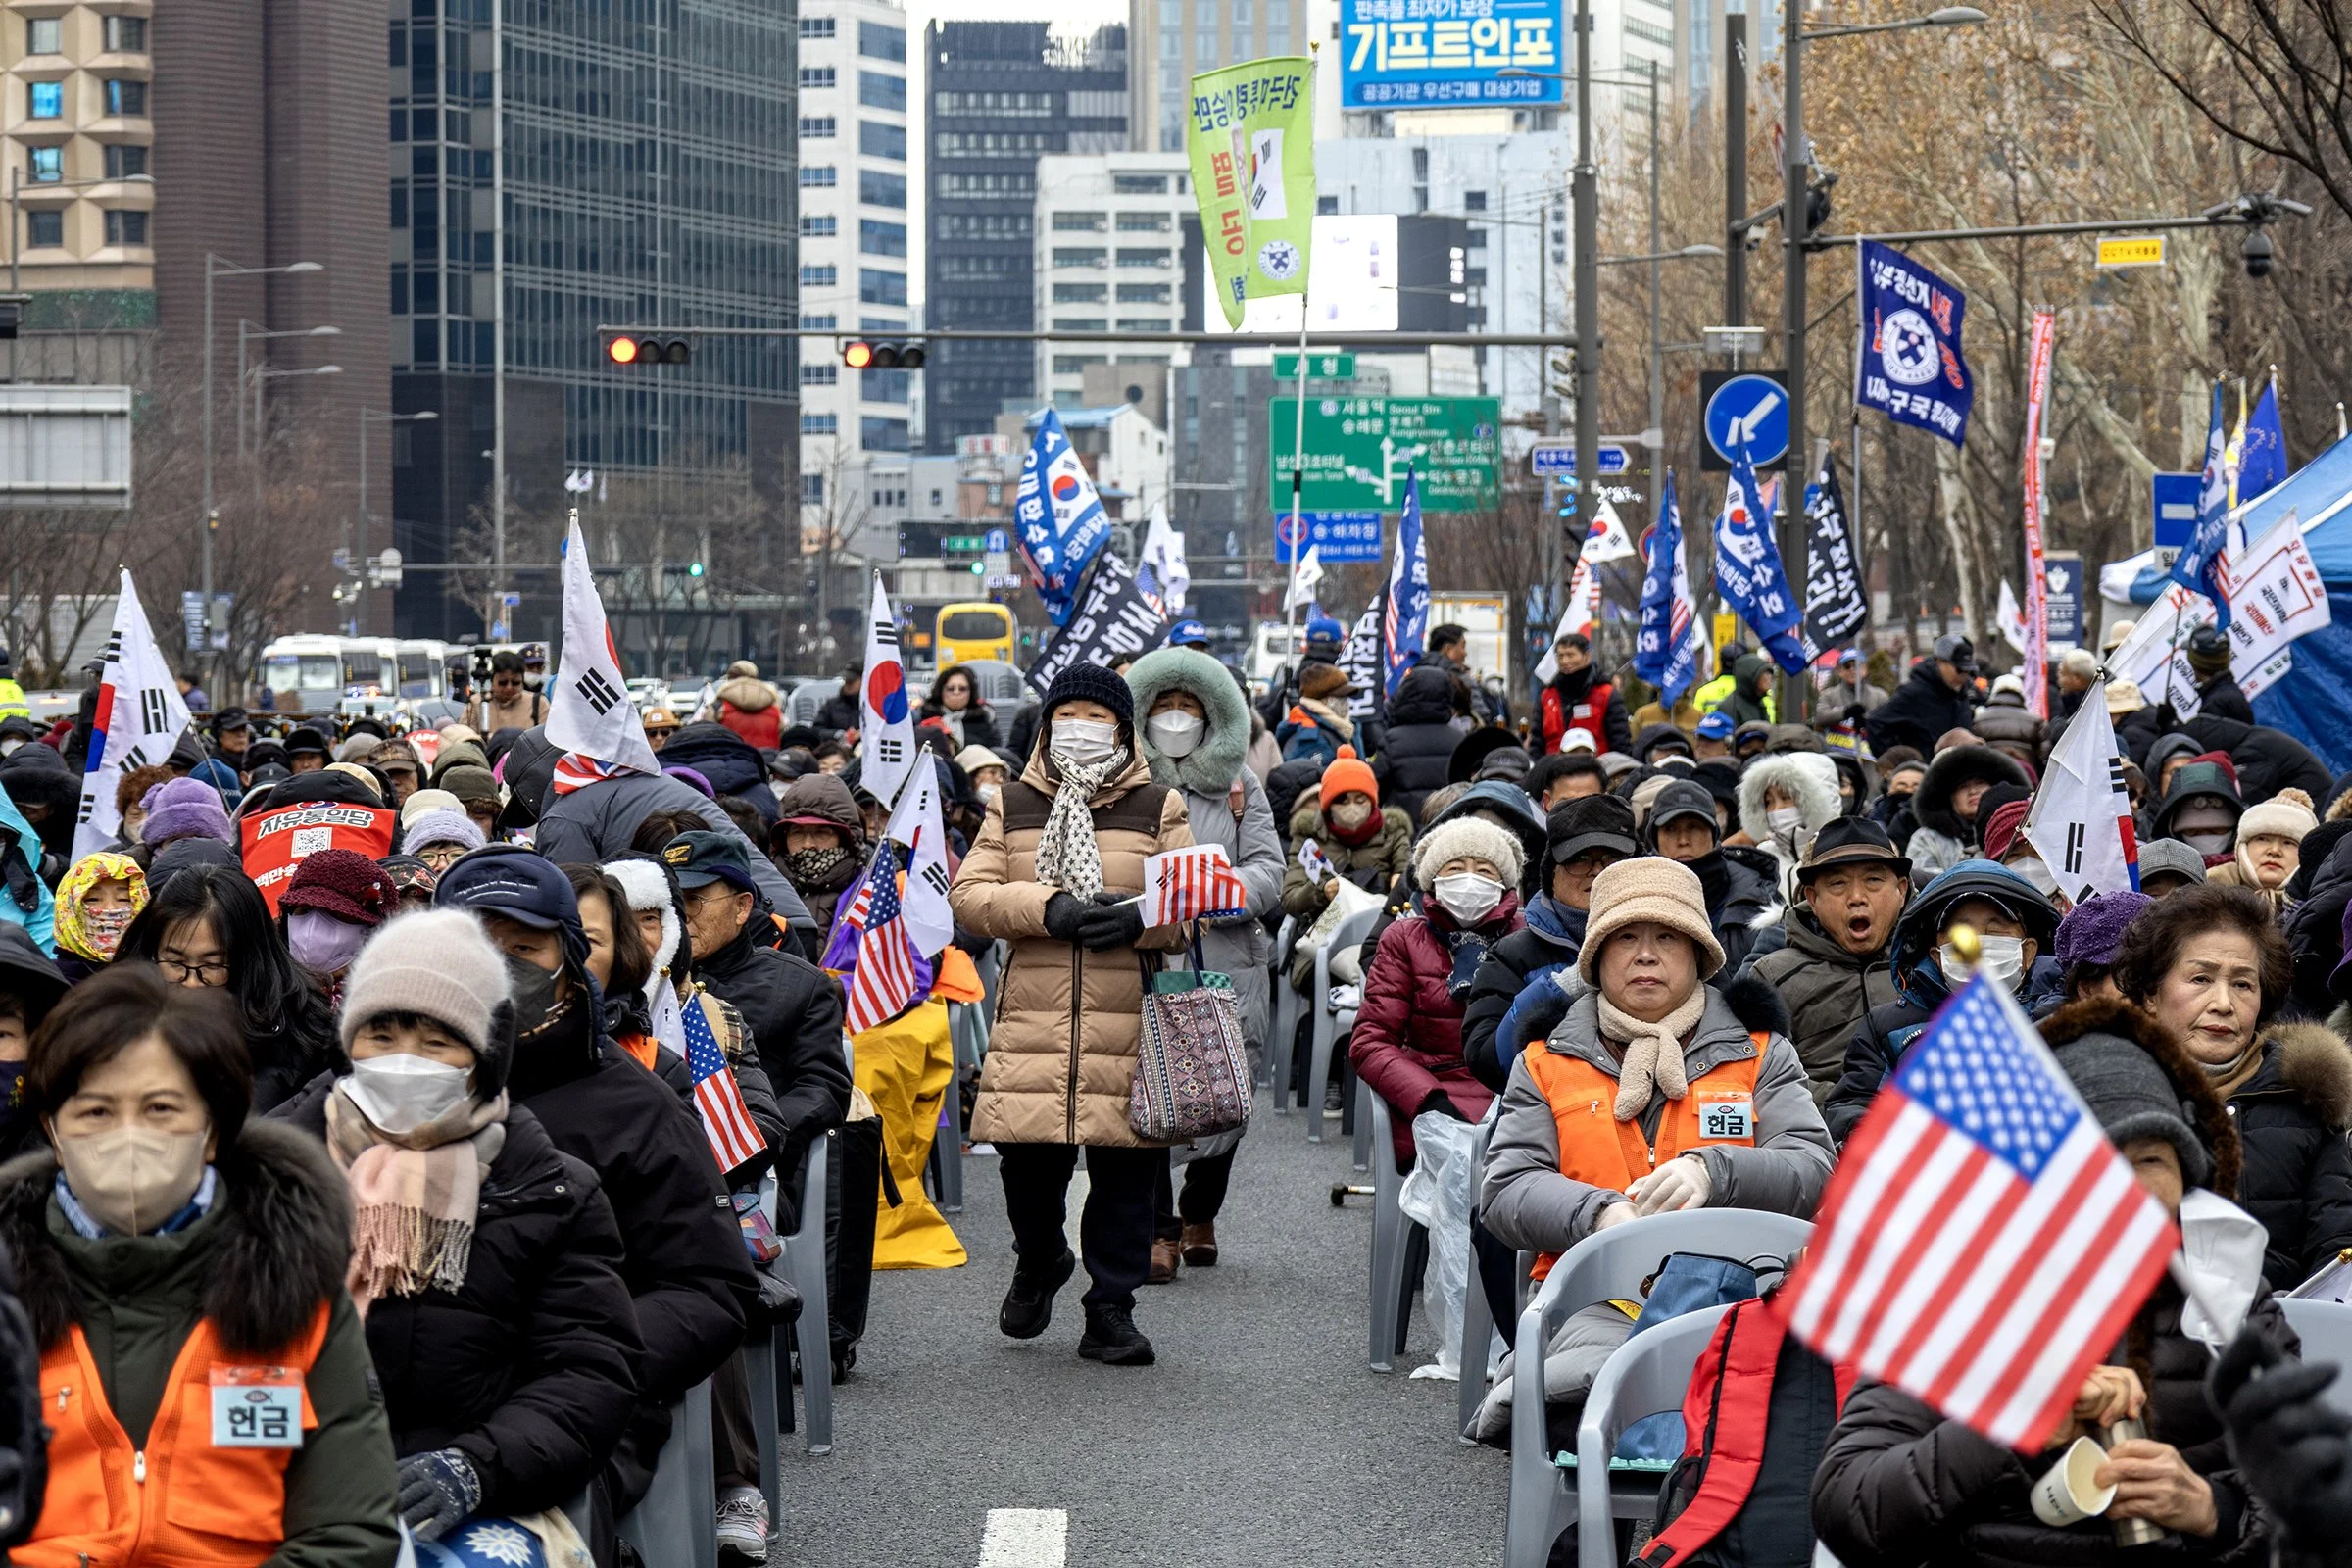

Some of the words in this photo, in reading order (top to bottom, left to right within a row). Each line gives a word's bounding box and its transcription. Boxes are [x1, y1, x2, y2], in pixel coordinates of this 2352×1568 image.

[1348, 17, 1556, 72] 기프트인포
[1362, 82, 1421, 101] 공공기관
[1423, 81, 1481, 99] 우선구매
[1484, 79, 1542, 97] 대상기업
[1342, 399, 1385, 416] 서울역
[1390, 403, 1419, 415] Seoul
[1342, 418, 1385, 435] 숭례문
[257, 808, 375, 840] 자유통일당
[1707, 1115, 1744, 1135] 헌금
[228, 1405, 290, 1439] 헌금
